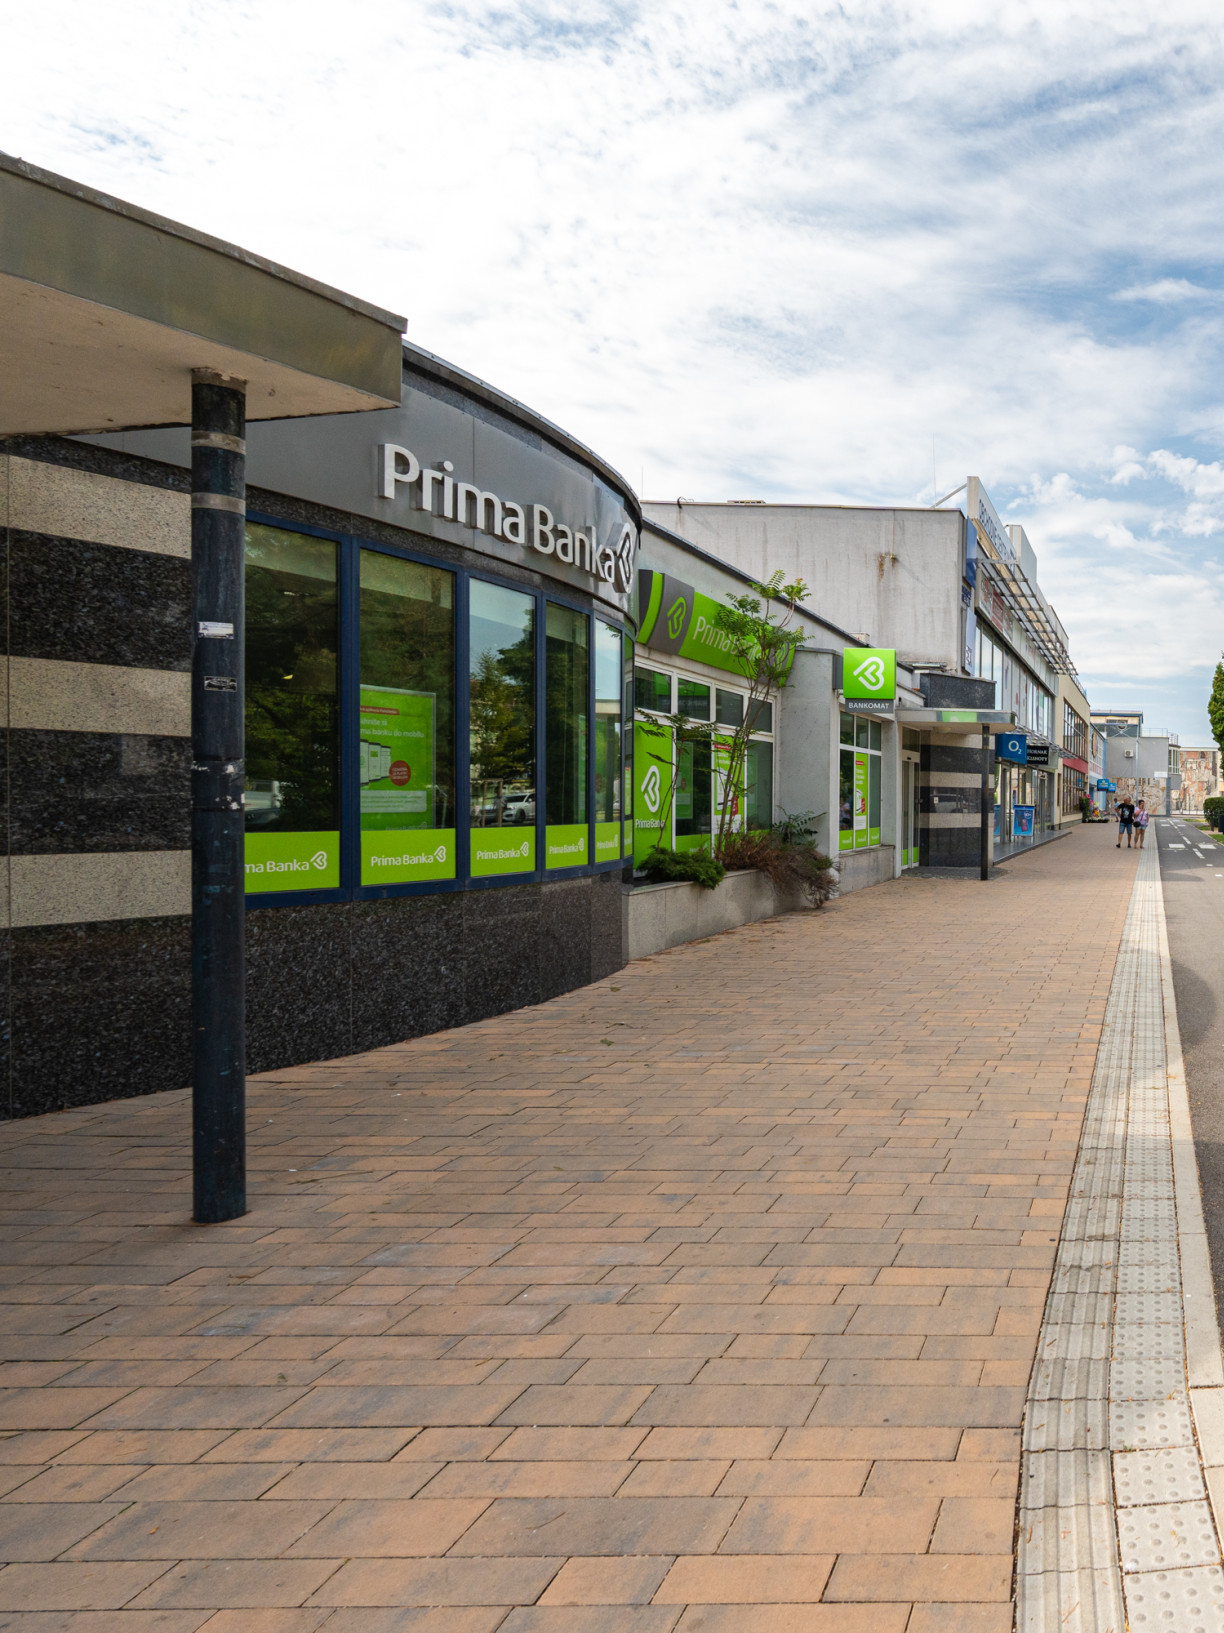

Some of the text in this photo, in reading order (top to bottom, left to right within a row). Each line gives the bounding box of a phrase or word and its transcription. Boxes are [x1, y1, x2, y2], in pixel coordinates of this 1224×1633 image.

[379, 442, 616, 584] Prima Banka
[692, 615, 731, 652] Prima
[848, 702, 890, 710] BANKOMAT
[636, 818, 650, 829] Prima
[371, 852, 434, 867] Prima Banka
[476, 848, 521, 860] Prima Banka
[266, 859, 310, 873] Banka
